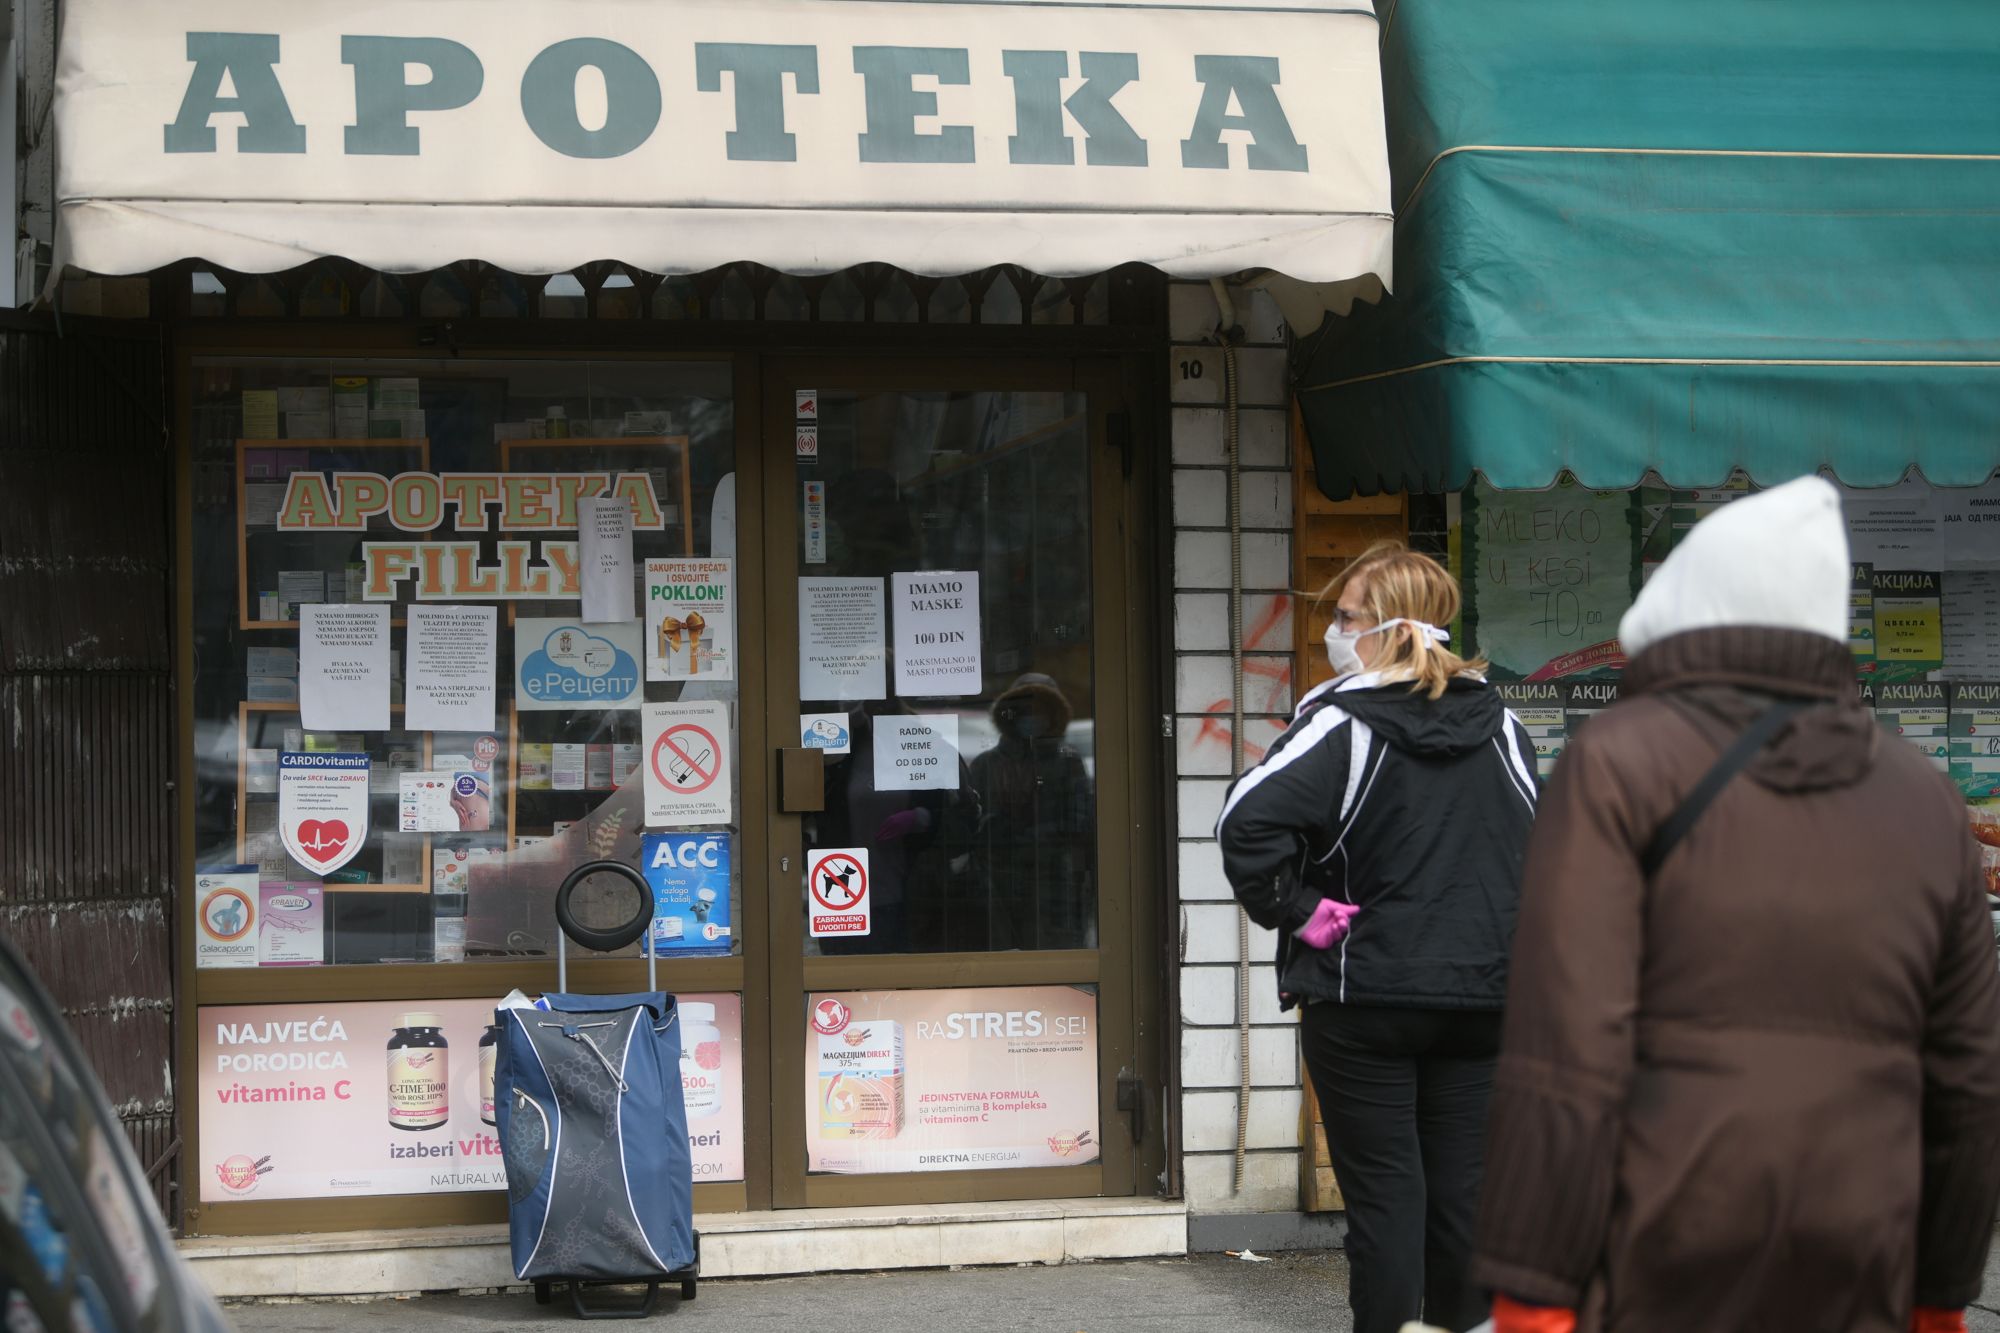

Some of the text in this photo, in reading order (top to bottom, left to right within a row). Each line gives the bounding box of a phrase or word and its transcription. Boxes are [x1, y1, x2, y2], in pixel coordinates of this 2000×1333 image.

[163, 30, 1309, 173] APOTEKA
[1180, 360, 1203, 379] 10
[277, 472, 665, 531] APOTEKA
[1486, 508, 1600, 544] MLEKO
[362, 540, 583, 601] FILLY
[648, 562, 727, 572] SAKUPITE 10 PEČATA
[672, 574, 710, 582] OSVOJITE
[1872, 574, 1935, 592] АКЦИЈА
[908, 581, 963, 595] IMAMO
[911, 598, 964, 612] MASKE
[914, 631, 965, 645] 100 DIN
[905, 655, 976, 667] MAKSIMALNO 10
[906, 665, 976, 677] MASKI PO OSOBI
[1496, 685, 1558, 702] АКЦИЈА
[1571, 685, 1617, 703] АКЦИ
[1882, 685, 1943, 702] АКЦИЈА
[899, 727, 932, 736] RADNO
[900, 742, 932, 750] VREME
[895, 757, 938, 767] OD 08 DO
[909, 772, 926, 781] 16H
[664, 877, 686, 885] Nema
[661, 886, 689, 896] razloga
[670, 895, 691, 904] kašalj
[816, 915, 864, 924] ZABRANJENO
[818, 923, 847, 931] UVODITI
[199, 944, 255, 954] Galacapsicum
[217, 1015, 349, 1045] NAJVEĆA
[916, 1010, 1086, 1040] RASTRESI SE!
[823, 1050, 890, 1060] MAGNEZIJUM DIREKT
[217, 1051, 349, 1073] PORODICA
[217, 1079, 352, 1104] vitamina C
[389, 1082, 446, 1094] C-TIME 1000
[919, 1090, 1040, 1103] JEDINSTVENA FORMULA
[919, 1101, 1047, 1114] sa vitaminima B kompleksa
[924, 1114, 979, 1124] vitaminom
[981, 1114, 989, 1122] C
[389, 1141, 454, 1159] izaberi
[919, 1152, 1021, 1164] DIREKTNA ENERGIJA!
[431, 1173, 490, 1186] NATURAL
